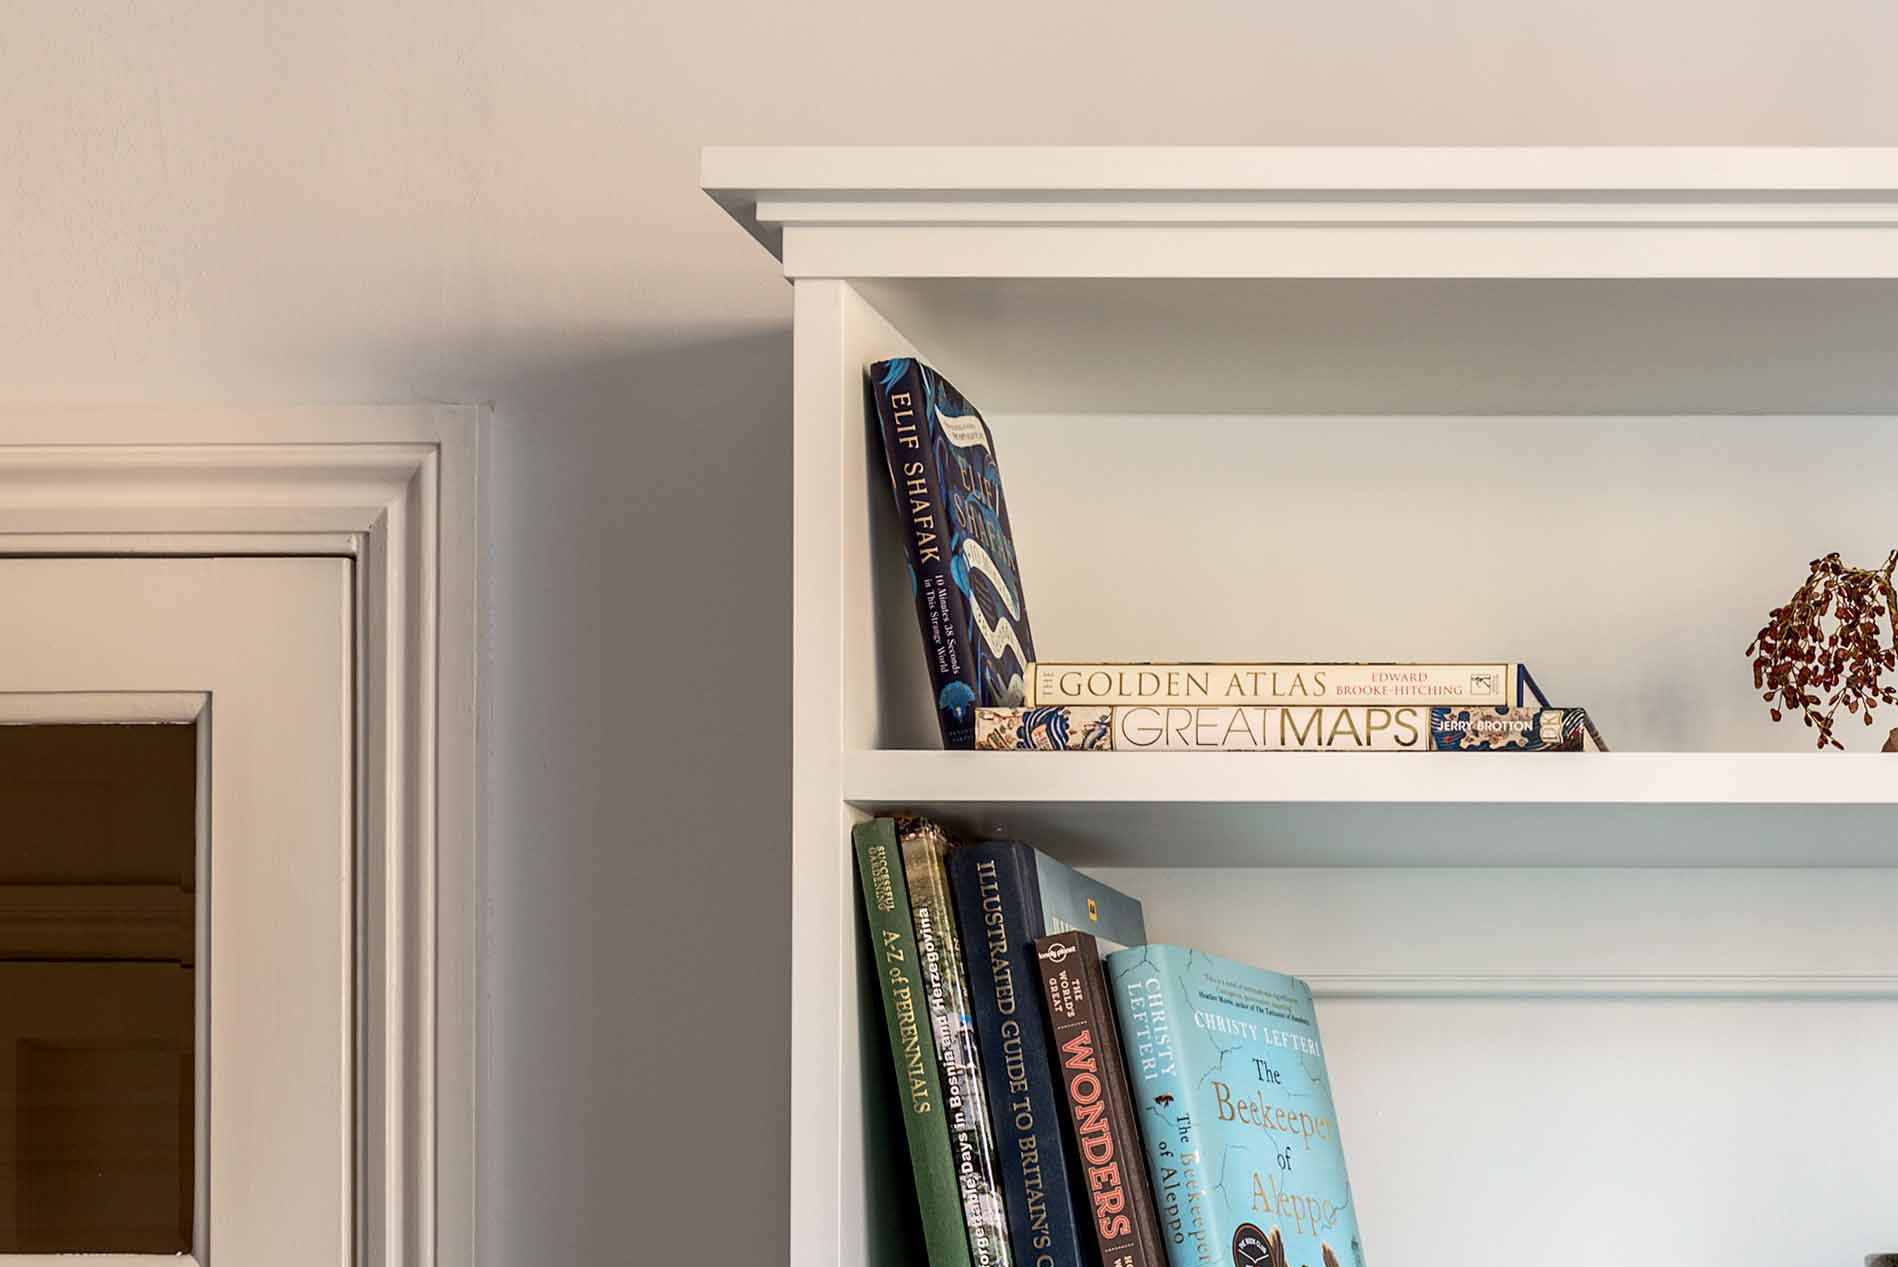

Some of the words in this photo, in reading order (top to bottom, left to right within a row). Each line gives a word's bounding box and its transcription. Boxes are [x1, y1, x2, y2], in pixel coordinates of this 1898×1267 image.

[891, 392, 919, 449] ELIF
[903, 461, 940, 565] SHAFAK
[924, 578, 933, 588] in
[935, 574, 945, 586] 10
[925, 589, 937, 610] This
[937, 587, 949, 623] Minutes
[929, 611, 942, 645] Strange
[944, 624, 953, 637] 38
[937, 646, 949, 673] World
[947, 639, 961, 675] Seconds
[1042, 672, 1054, 696] THE
[1059, 671, 1209, 697] GOLDEN
[1225, 671, 1327, 697] ATLAS
[1335, 684, 1463, 696] BROOKE-HITCHING
[1371, 672, 1428, 683] EDWARD
[1437, 719, 1473, 732] JERRY
[1476, 720, 1534, 732] BROTTON
[1542, 710, 1561, 744] DK
[869, 847, 888, 913] GARDENING
[876, 845, 895, 912] SUCCESSFUL
[882, 929, 905, 963] A-Z
[976, 860, 1017, 1016] ILLUSTRATED
[1038, 948, 1058, 961] lonely
[1057, 945, 1076, 958] planet
[889, 965, 908, 985] of
[919, 907, 944, 1011] Herzegovina
[1048, 977, 1063, 1012] GREAT
[1058, 969, 1076, 1018] WORLD'S
[1071, 978, 1083, 1001] THE
[936, 1014, 950, 1047] and
[1127, 982, 1158, 1081] LEFTERI
[1145, 977, 1176, 1077] CHRISTY
[1194, 1009, 1257, 1041] CHRISTY
[1263, 1027, 1320, 1057] LEFTERI
[893, 987, 931, 1114] PERENNIALS
[1000, 1022, 1029, 1095] GUIDE
[942, 1049, 964, 1109] Bosnia
[1252, 1057, 1281, 1085] The
[953, 1112, 967, 1129] in
[1012, 1097, 1034, 1132] TO
[1176, 1112, 1191, 1144] The
[958, 1131, 974, 1173] Days
[1062, 1029, 1131, 1240] WONDERS
[1158, 1141, 1174, 1158] of
[1277, 1145, 1293, 1171] of
[1018, 1135, 1051, 1250] BRITAIN'S
[1160, 1167, 1185, 1245] Aleppo
[1180, 1150, 1211, 1265] Beekeeper
[1251, 1171, 1337, 1238] Aleppo
